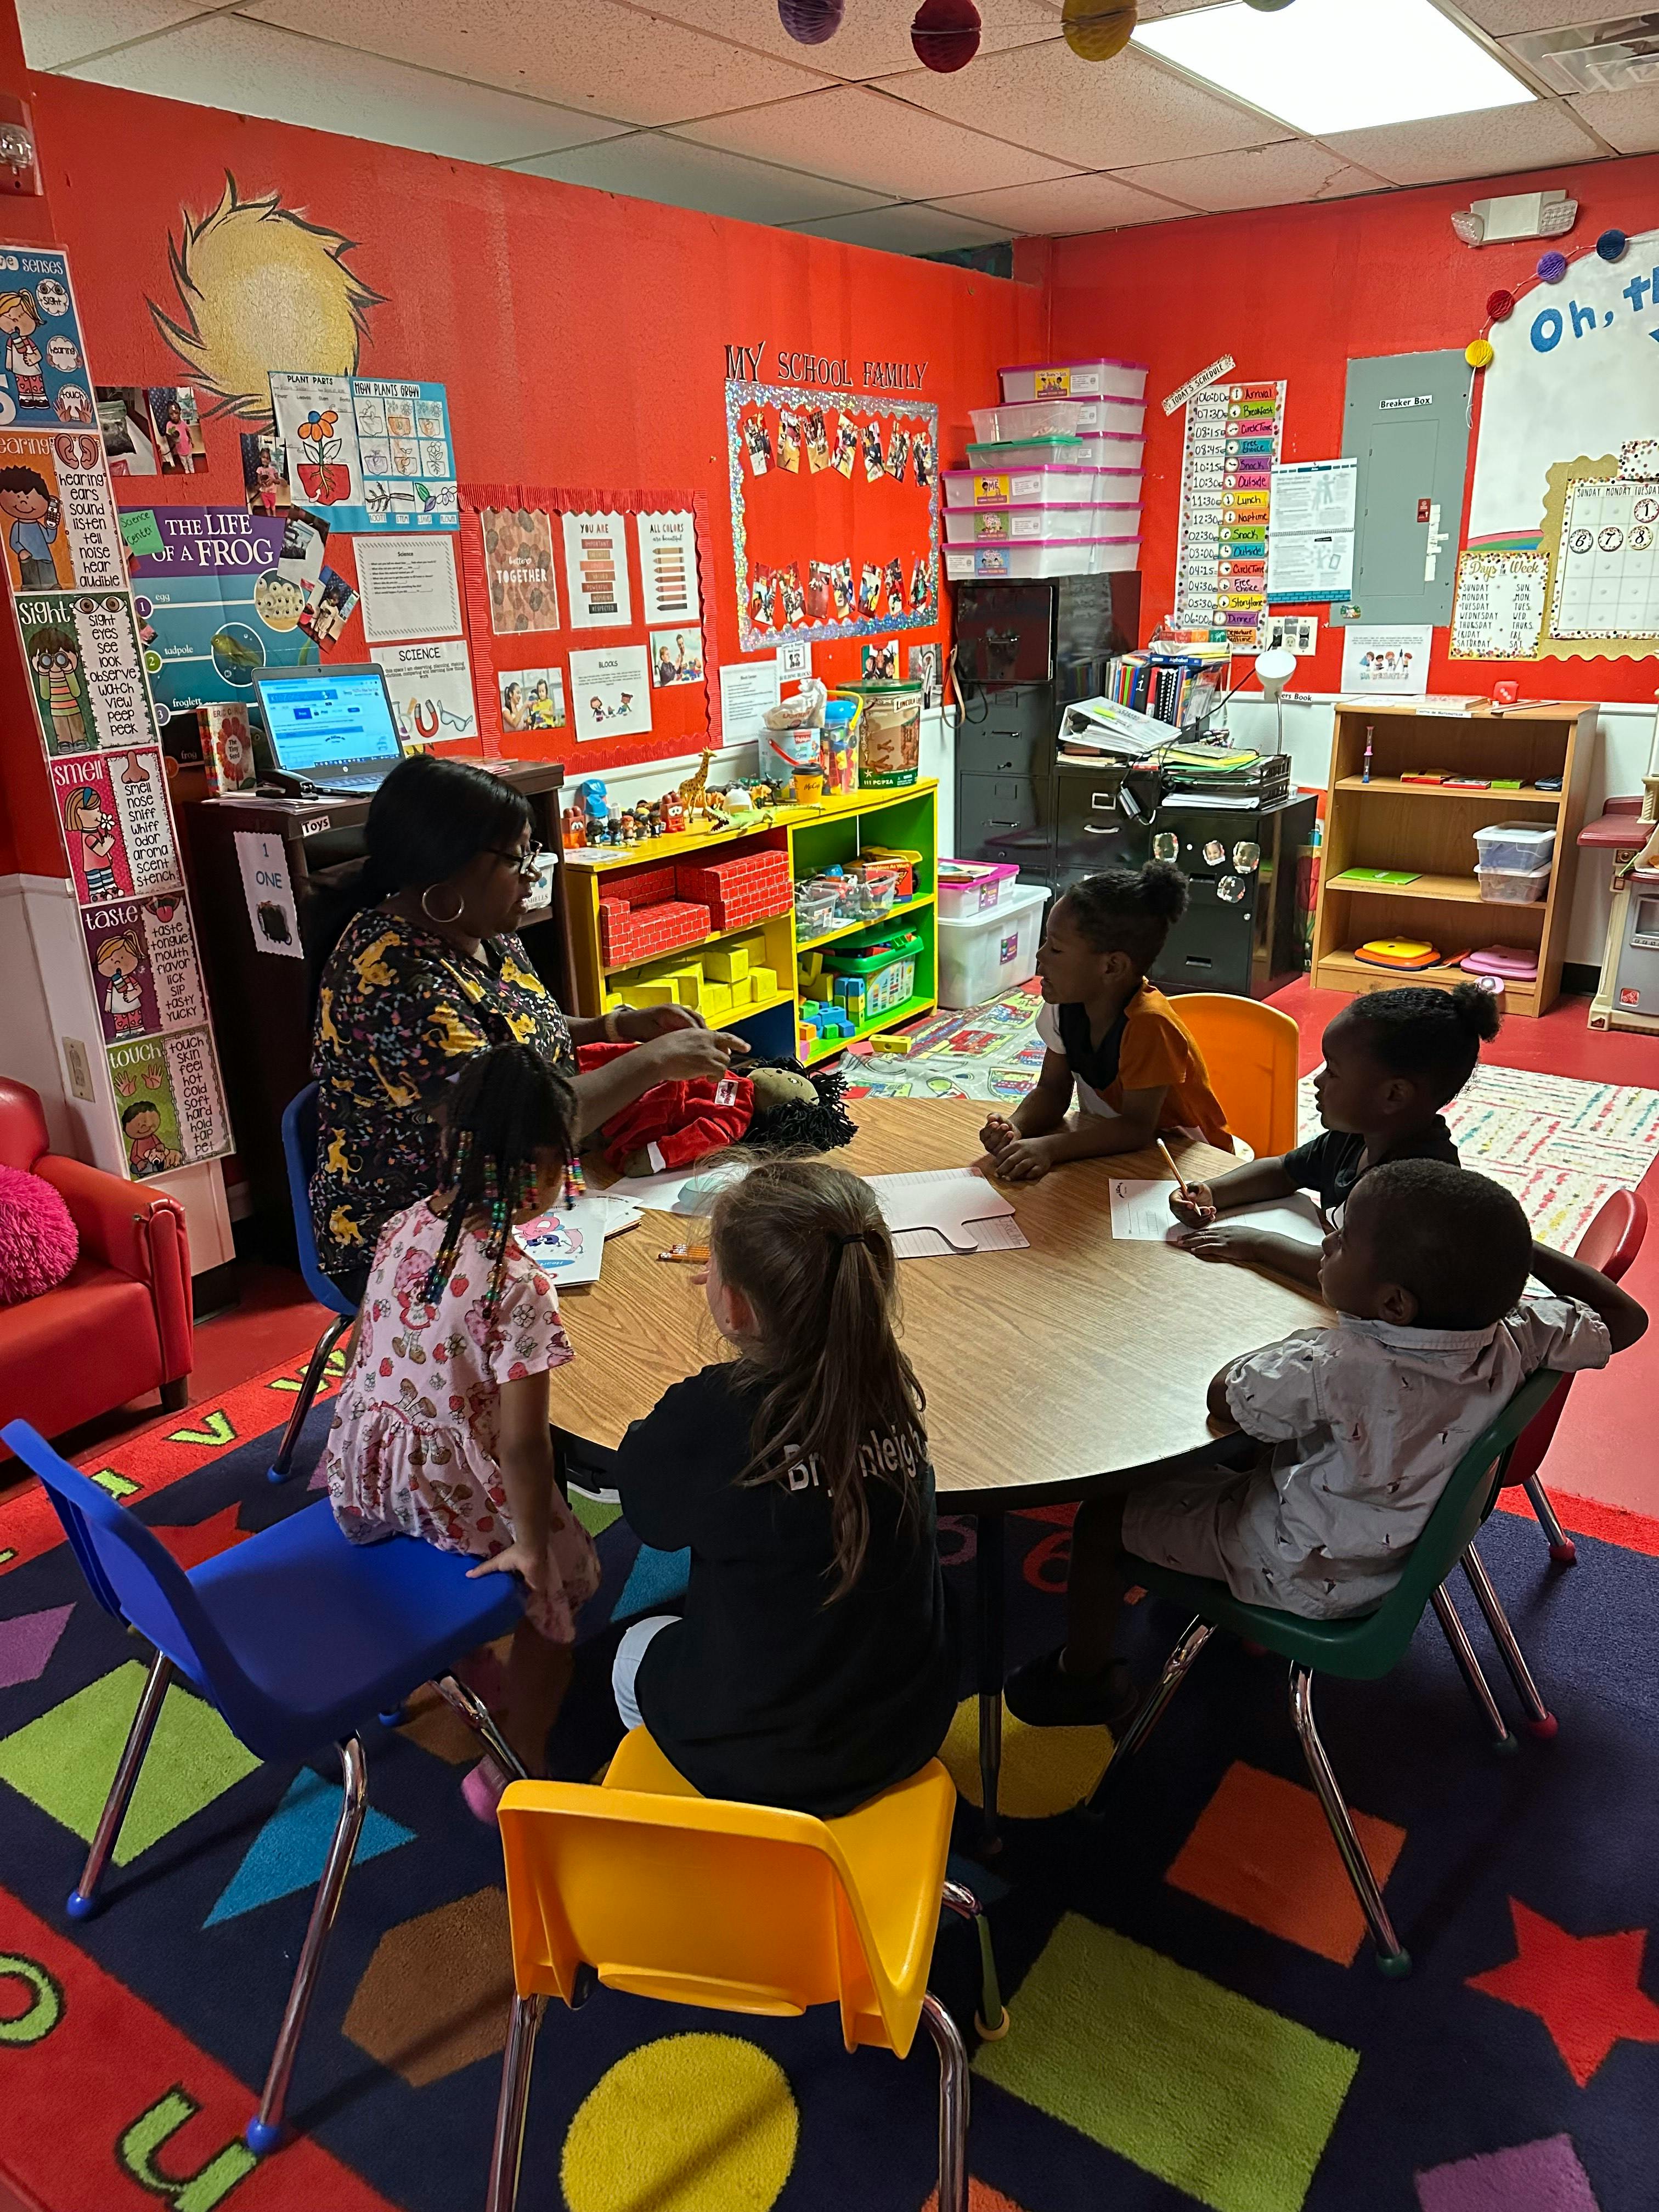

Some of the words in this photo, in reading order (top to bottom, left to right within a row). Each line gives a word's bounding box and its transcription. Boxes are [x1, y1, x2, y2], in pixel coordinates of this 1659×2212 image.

[22, 258, 63, 274] senses
[1530, 300, 1614, 353] Oh,
[724, 341, 766, 383] MY
[778, 352, 853, 387] SCHOOL
[864, 362, 928, 390] FAMILY
[287, 375, 308, 383] PLANT
[313, 377, 333, 385] PARTS
[1171, 385, 1194, 404] TODAY'S
[1195, 363, 1224, 387] SCHEDULE
[354, 382, 370, 395] HOW
[374, 384, 398, 396] PLANTS
[400, 386, 419, 397] GROW
[1245, 389, 1272, 399] Arrival
[1380, 398, 1412, 408] Breaker
[1414, 396, 1430, 405] Box
[1198, 409, 1224, 419] 07:30
[1244, 405, 1273, 417] Breakfast
[1196, 427, 1221, 438] 08:15
[1195, 446, 1222, 454] 08:45
[1194, 461, 1221, 473] 10:15
[59, 473, 104, 487] hearing
[1193, 477, 1219, 488] 10:30
[1238, 477, 1266, 487] Outside
[71, 488, 99, 500] ears
[1577, 488, 1600, 497] SUNDAY
[1606, 487, 1631, 496] MONDAY
[1635, 486, 1659, 495] TUESDAY
[1192, 496, 1217, 506] 11:30
[1237, 496, 1261, 505] Lunch
[70, 504, 104, 515] sound
[1644, 503, 1649, 516] 1
[74, 518, 106, 529] listen
[120, 512, 150, 527] Science
[165, 519, 204, 535] THE
[204, 515, 253, 535] LIFE
[1194, 514, 1218, 525] 12:30
[1238, 513, 1268, 522] Naptime
[580, 524, 594, 534] YOU
[597, 524, 608, 533] ARE
[650, 524, 661, 533] ALL
[663, 523, 684, 532] COLORS
[1189, 531, 1214, 541] 02:30
[1234, 529, 1258, 539] Snack
[84, 533, 102, 544] tell
[1576, 535, 1587, 546] 6
[1606, 532, 1616, 545] 7
[1635, 530, 1645, 544] 8
[80, 547, 110, 558] noise
[180, 548, 194, 561] A
[195, 539, 274, 566] FROG
[1189, 549, 1214, 558] 03:00
[1234, 547, 1262, 556] Outside
[83, 561, 111, 573] hear
[1189, 566, 1214, 575] 04:15
[1469, 561, 1497, 582] Days
[1510, 561, 1540, 573] Week
[80, 575, 120, 586] audible
[496, 569, 548, 584] TOGETHER
[1188, 582, 1213, 591] 04:30
[141, 602, 145, 612] 1
[156, 594, 170, 602] egg
[1188, 599, 1213, 608] 05:30
[1184, 613, 1209, 624] 06:00
[98, 642, 118, 654] see
[1457, 640, 1491, 648] SATURDAY
[150, 657, 155, 666] 2
[165, 646, 193, 655] tadpole
[399, 647, 441, 661] SCIENCE
[99, 656, 121, 667] look
[90, 668, 137, 682] observe
[98, 683, 134, 696] watch
[105, 697, 132, 708] view
[108, 710, 134, 722] peep
[158, 709, 163, 719] 3
[110, 724, 138, 736] peek
[182, 750, 197, 759] frog
[55, 760, 103, 786] smell
[125, 782, 151, 795] smell
[127, 794, 153, 809] nose
[129, 808, 156, 822] sniff
[131, 821, 159, 835] whiff
[302, 817, 329, 833] Toys
[135, 833, 160, 847] odor
[133, 845, 168, 860] aroma
[262, 843, 269, 857] 1
[137, 859, 168, 873] scent
[137, 871, 175, 887] stench
[256, 871, 283, 889] ONE
[85, 905, 138, 930] taste
[153, 922, 183, 937] taste
[151, 933, 188, 950] tongue
[155, 947, 188, 962] mouth
[157, 958, 190, 974] flavor
[167, 972, 185, 985] lick
[171, 984, 185, 996] sip
[166, 995, 194, 1009] tasty
[167, 1006, 196, 1022] yucky
[169, 1037, 204, 1053] touch
[110, 1043, 161, 1069] touch
[177, 1049, 200, 1064] skin
[180, 1060, 202, 1075] feel
[183, 1074, 202, 1087] hot
[184, 1084, 206, 1098] cold
[185, 1096, 209, 1110] soft
[187, 1106, 212, 1121] hard
[191, 1118, 212, 1132] hold
[193, 1128, 213, 1143] tap
[195, 1141, 215, 1155] pet
